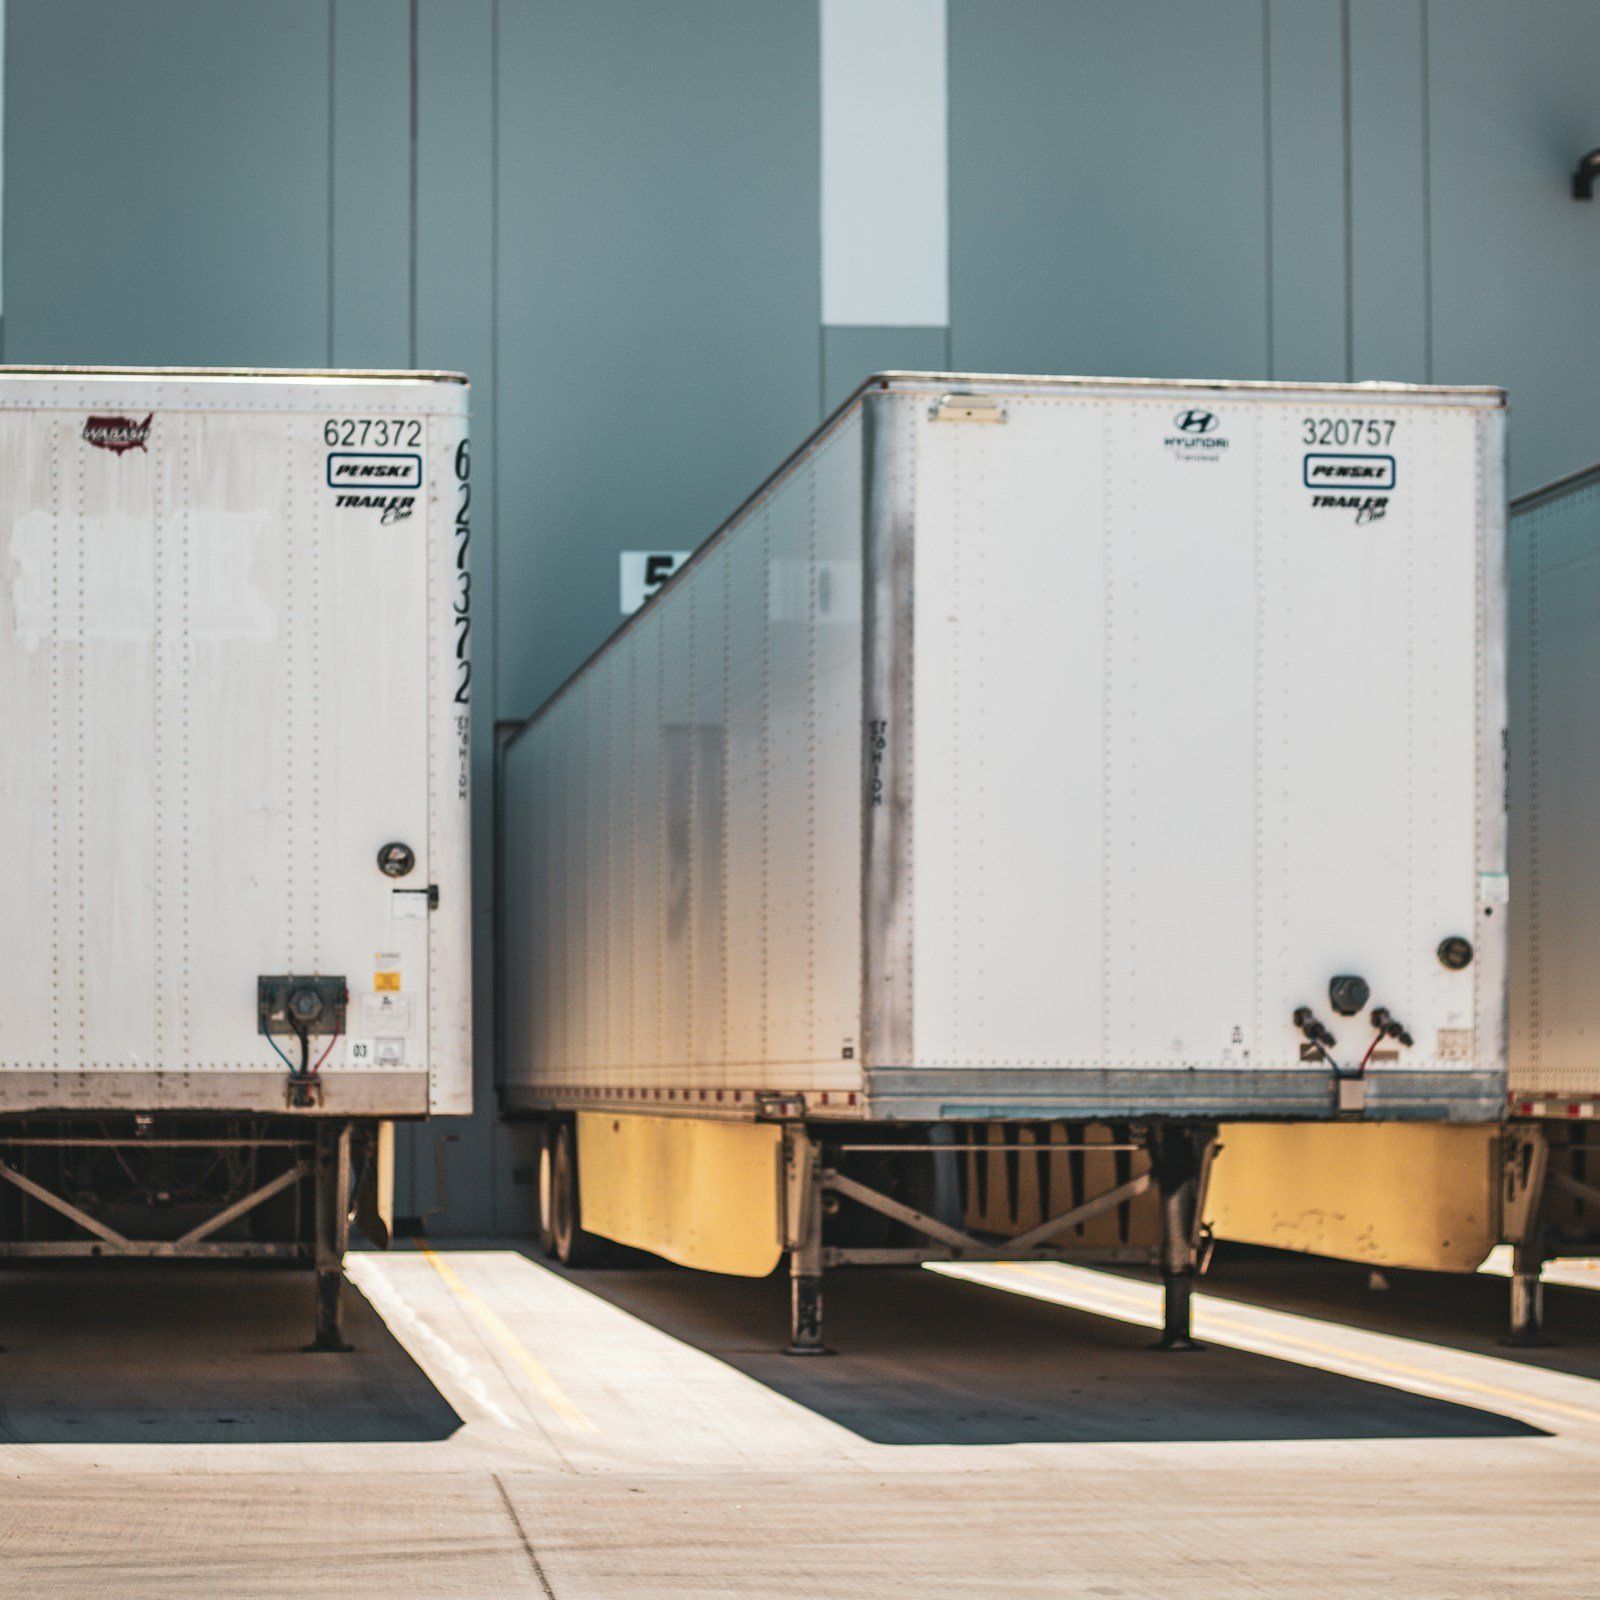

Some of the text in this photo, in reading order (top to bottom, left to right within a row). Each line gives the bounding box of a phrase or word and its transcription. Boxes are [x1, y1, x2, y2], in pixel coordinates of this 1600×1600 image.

[324, 419, 422, 447] 627372
[1303, 419, 1396, 446] 320757
[1164, 437, 1229, 447] HYUNDAI
[335, 464, 413, 477] PENSKE
[1312, 465, 1386, 478] PENSKE
[335, 495, 415, 508] TRAILER
[1312, 496, 1389, 508] TRAILER
[454, 438, 471, 705] 627372
